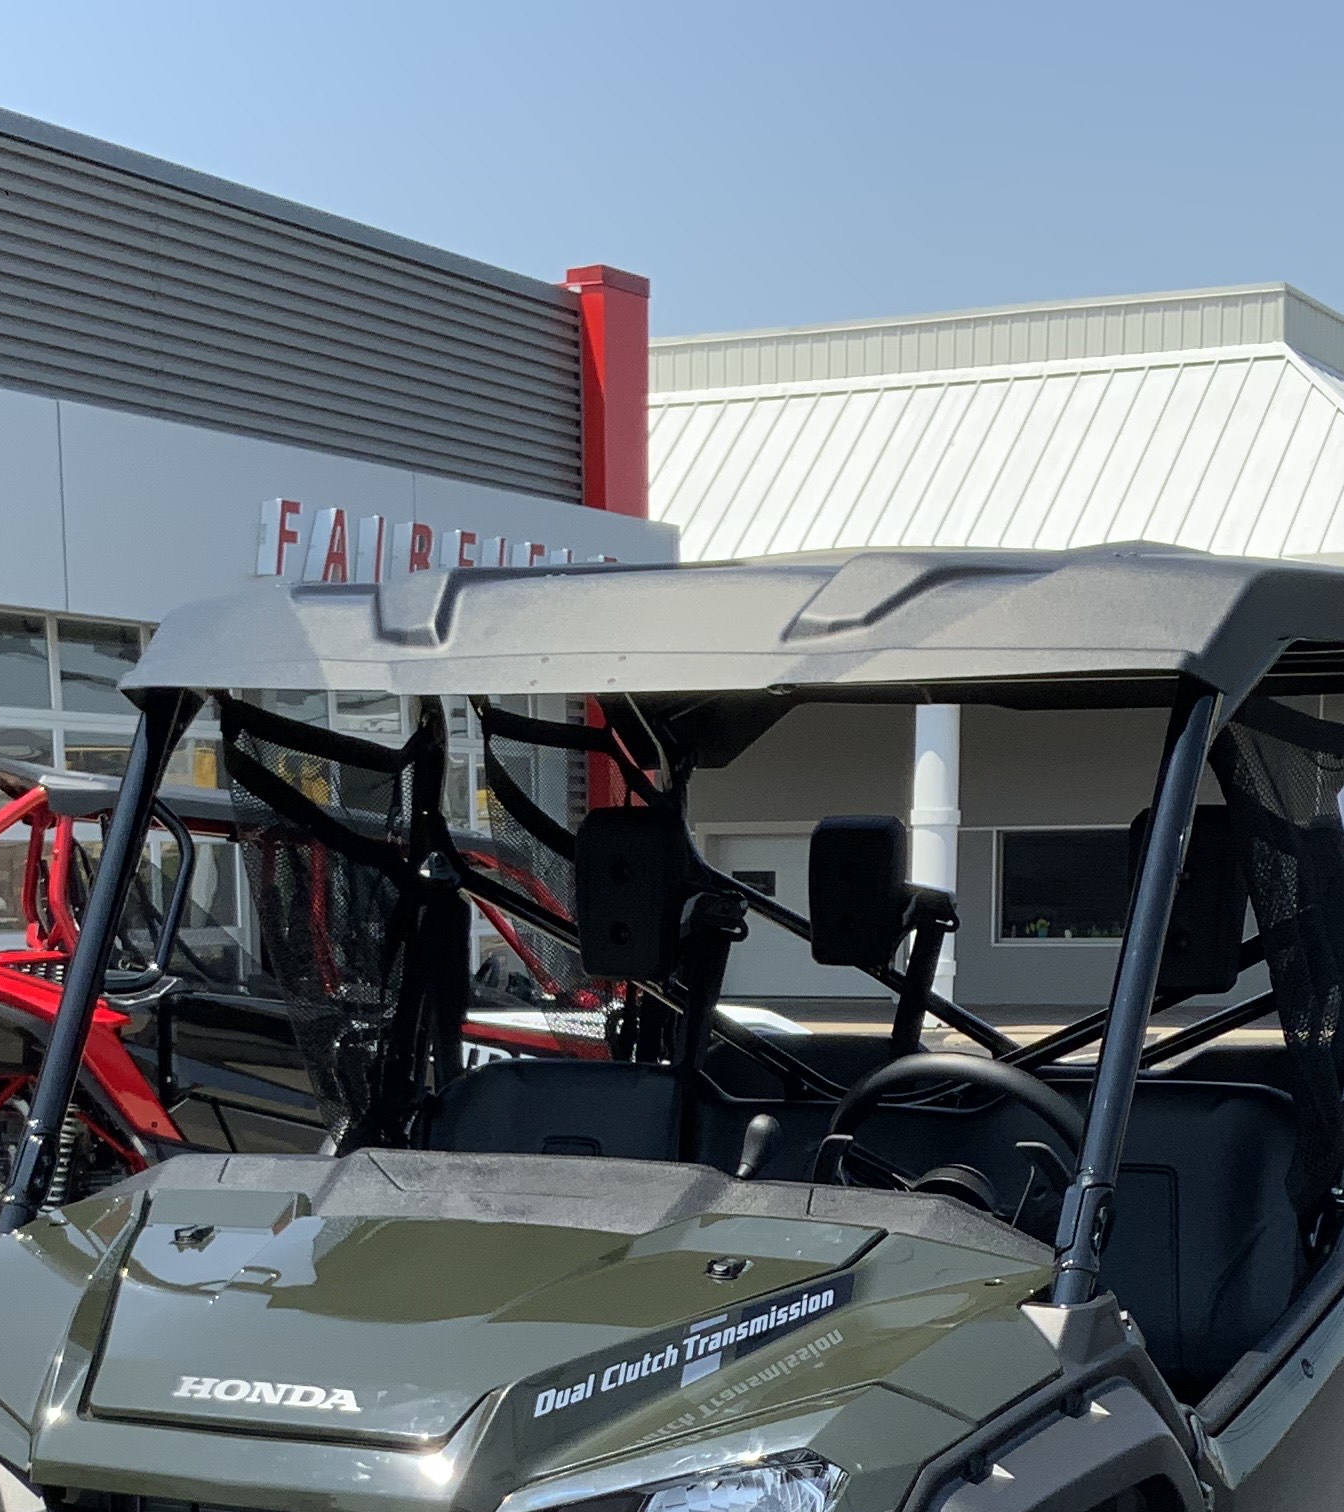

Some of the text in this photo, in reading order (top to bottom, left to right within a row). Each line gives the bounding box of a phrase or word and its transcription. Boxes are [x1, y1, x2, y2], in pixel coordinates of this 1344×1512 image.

[256, 498, 618, 584] FAIRFI
[172, 1375, 364, 1412] HONDA
[533, 1288, 835, 1418] Dual Clutch Transmission
